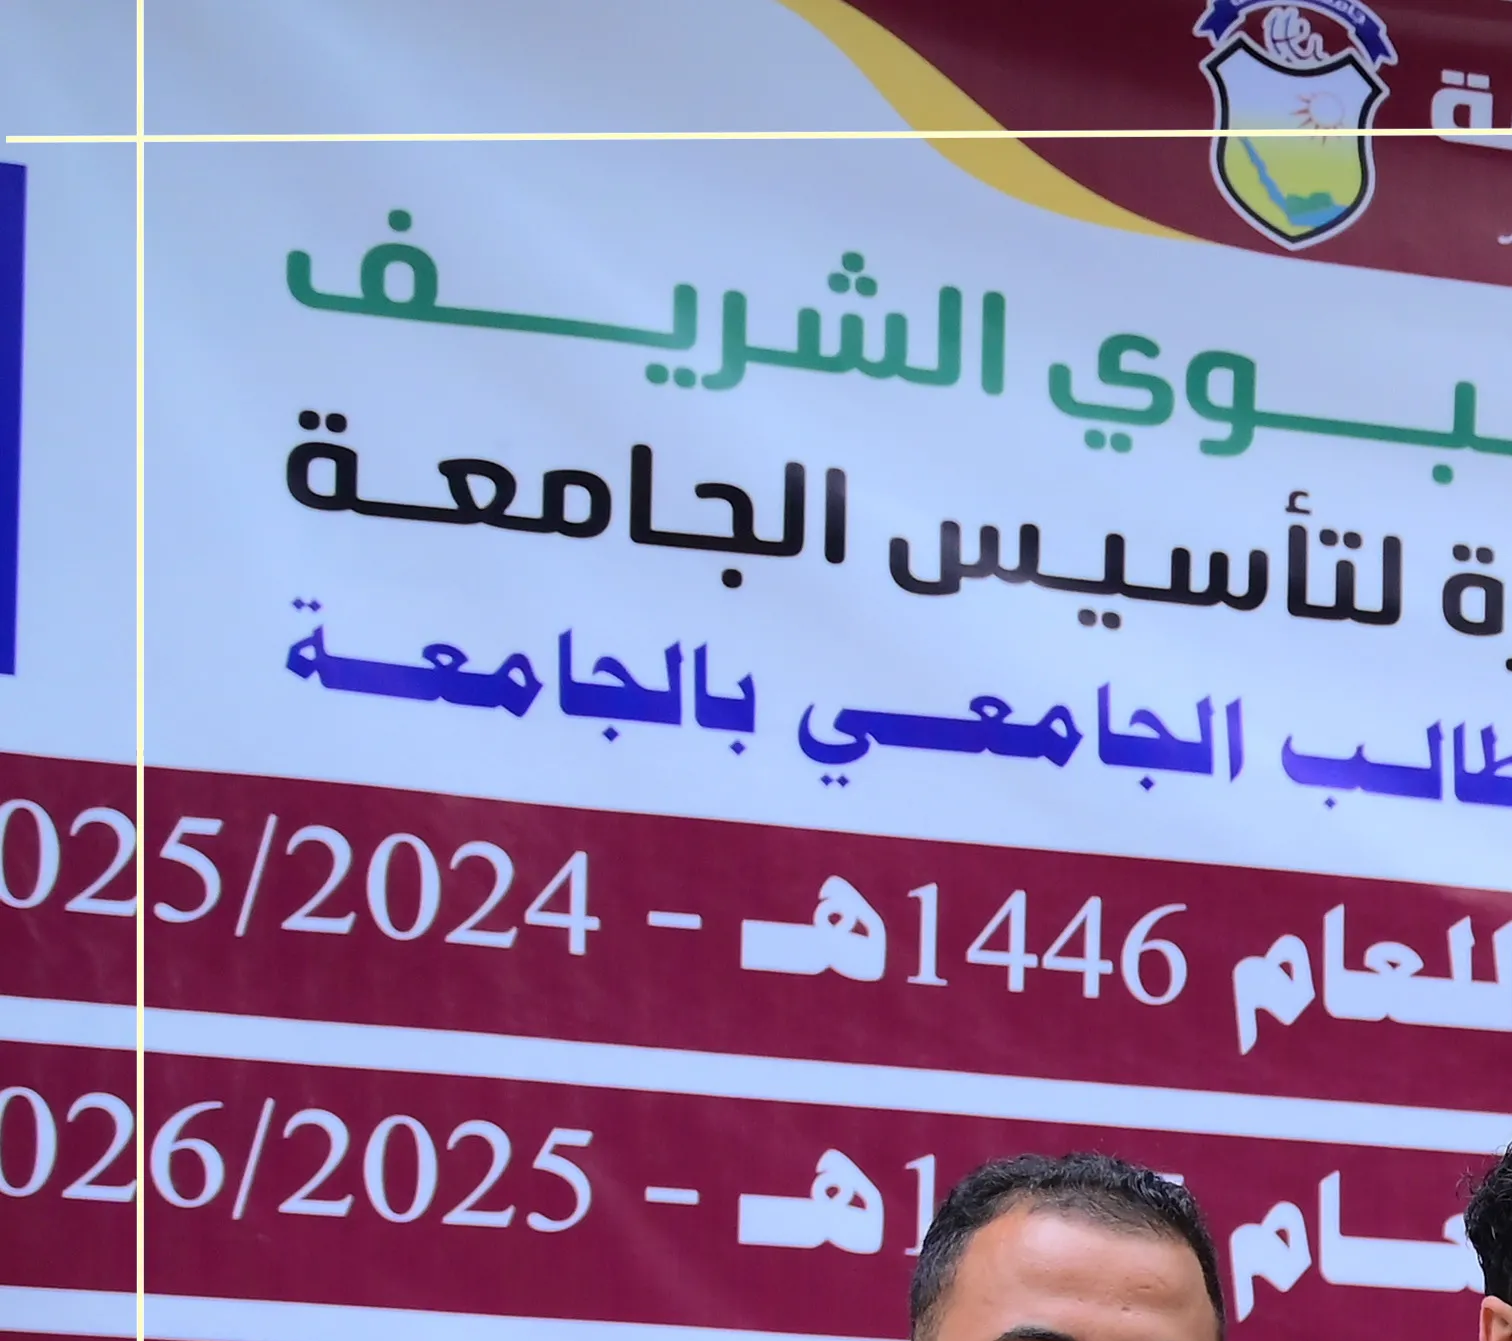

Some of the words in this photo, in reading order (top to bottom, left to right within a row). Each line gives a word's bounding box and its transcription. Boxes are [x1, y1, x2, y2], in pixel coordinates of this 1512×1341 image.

[286, 209, 1007, 397] الشريف
[286, 410, 847, 590] الجامعة
[888, 490, 1403, 631] لتأسيس
[285, 598, 758, 757] بالجامعة
[798, 684, 1245, 790] الجامعي
